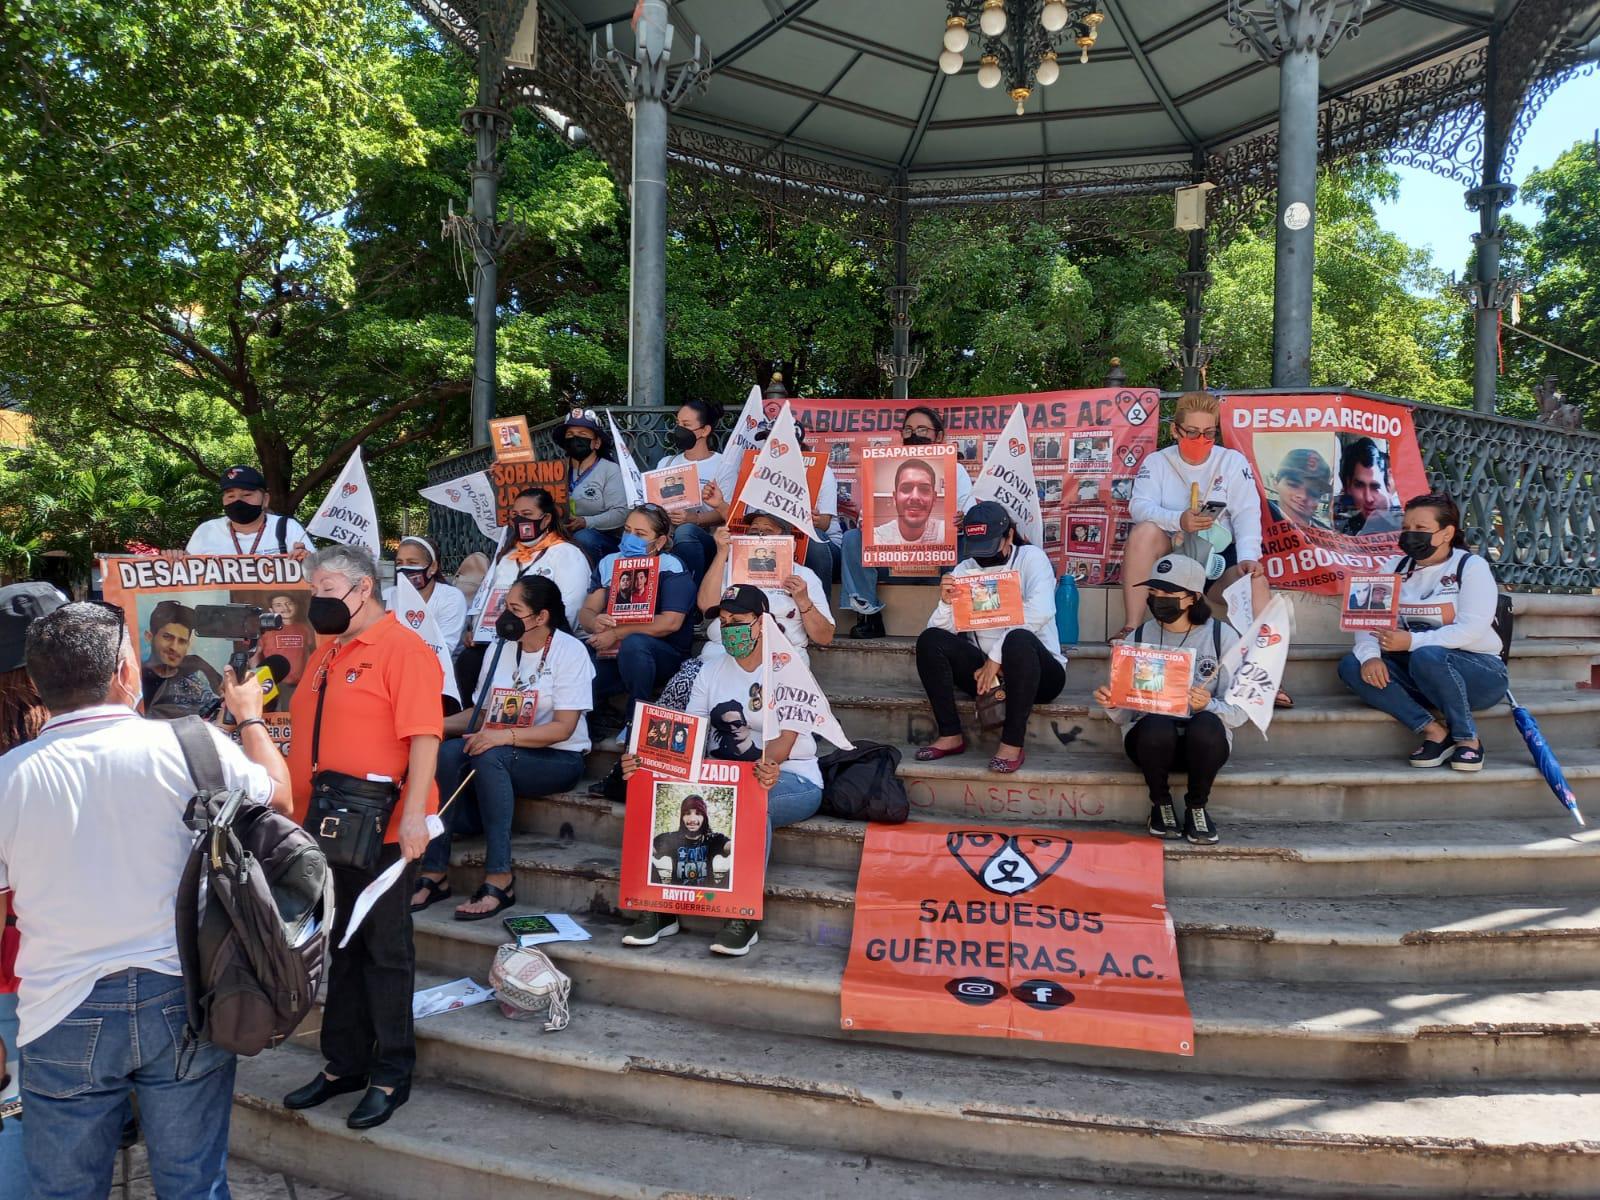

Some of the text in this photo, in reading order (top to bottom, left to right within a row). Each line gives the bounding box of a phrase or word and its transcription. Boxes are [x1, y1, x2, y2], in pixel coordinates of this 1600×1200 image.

[1076, 399, 1113, 427] AC
[1232, 407, 1402, 437] DESAPARECIDO
[862, 446, 956, 459] DESAPARECIDO
[494, 461, 565, 486] SOBRINO
[754, 466, 806, 501] ¿DÓNDE
[986, 464, 1034, 503] ¿DÓNDE
[321, 505, 370, 533] ¿DÓNDE
[763, 490, 812, 525] ESTÁN?
[993, 486, 1034, 526] ESTÁN?
[1267, 524, 1279, 537] 18
[863, 550, 956, 562] 018006703600
[1262, 534, 1300, 556] ARLOS
[118, 557, 304, 588] DESAPARECID
[618, 558, 654, 569] JUSTICIA
[955, 572, 1013, 584] DESAPARECIDA
[1120, 649, 1185, 662] DESAPARECIDA
[767, 682, 820, 709] ¿ÓNDE
[776, 704, 825, 727] STÁN?
[662, 888, 696, 902] RAYITO
[918, 899, 1104, 935] SABUESOS
[865, 938, 1165, 981] GUERRERAS, A.C.
